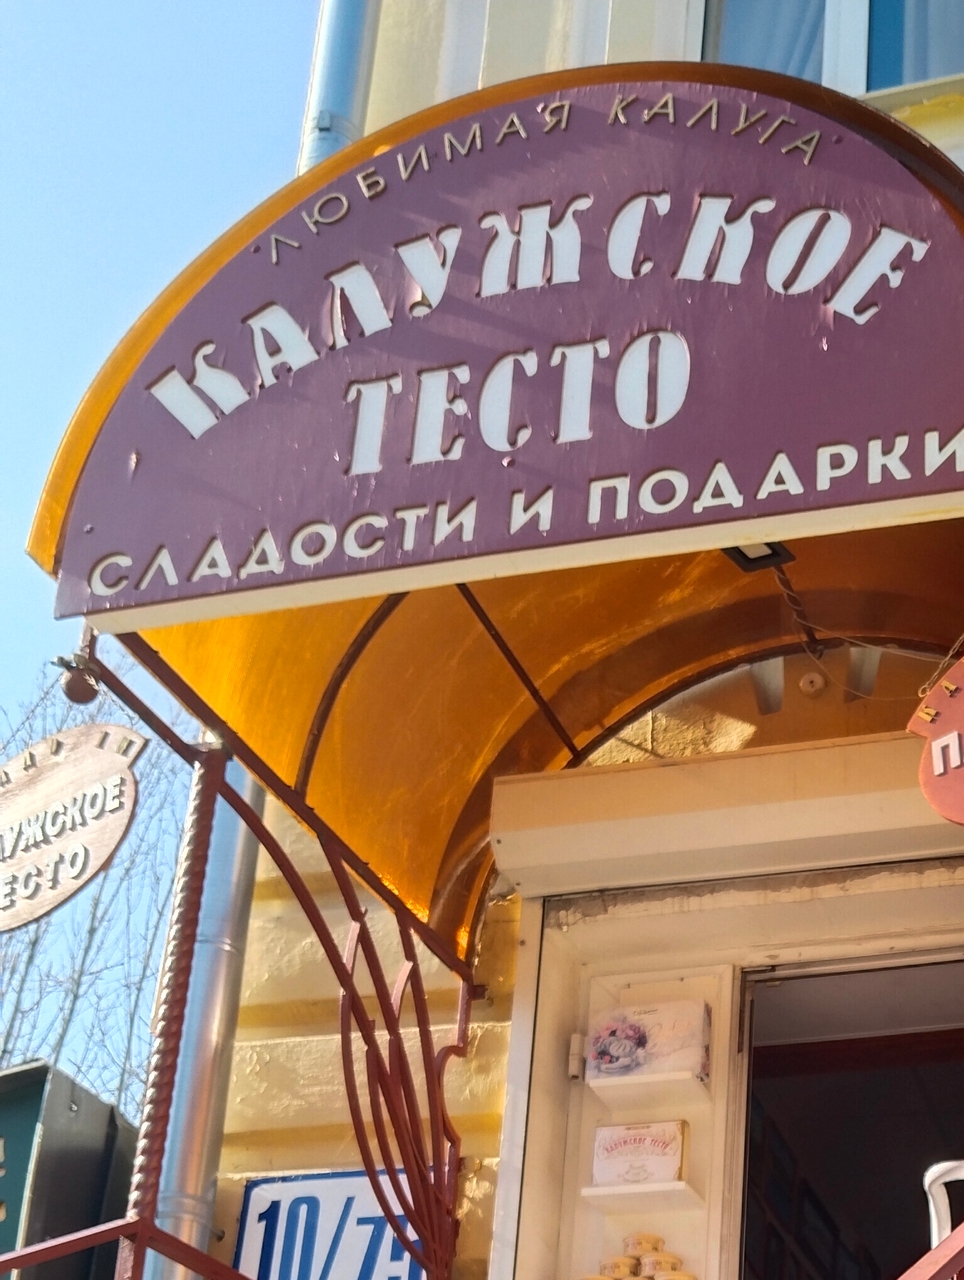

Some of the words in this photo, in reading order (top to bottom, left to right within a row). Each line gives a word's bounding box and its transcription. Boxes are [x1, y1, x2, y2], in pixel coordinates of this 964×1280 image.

[268, 97, 575, 266] ЛЮБИМАЯ
[606, 91, 828, 167] КАЛУГА
[147, 188, 934, 442] КАЛУЖСКОЕ
[343, 328, 693, 478] ТЕСТО
[88, 493, 479, 598] СЛАДОСТИ
[508, 483, 554, 537] И
[0, 772, 124, 863] УЖСКОЕ
